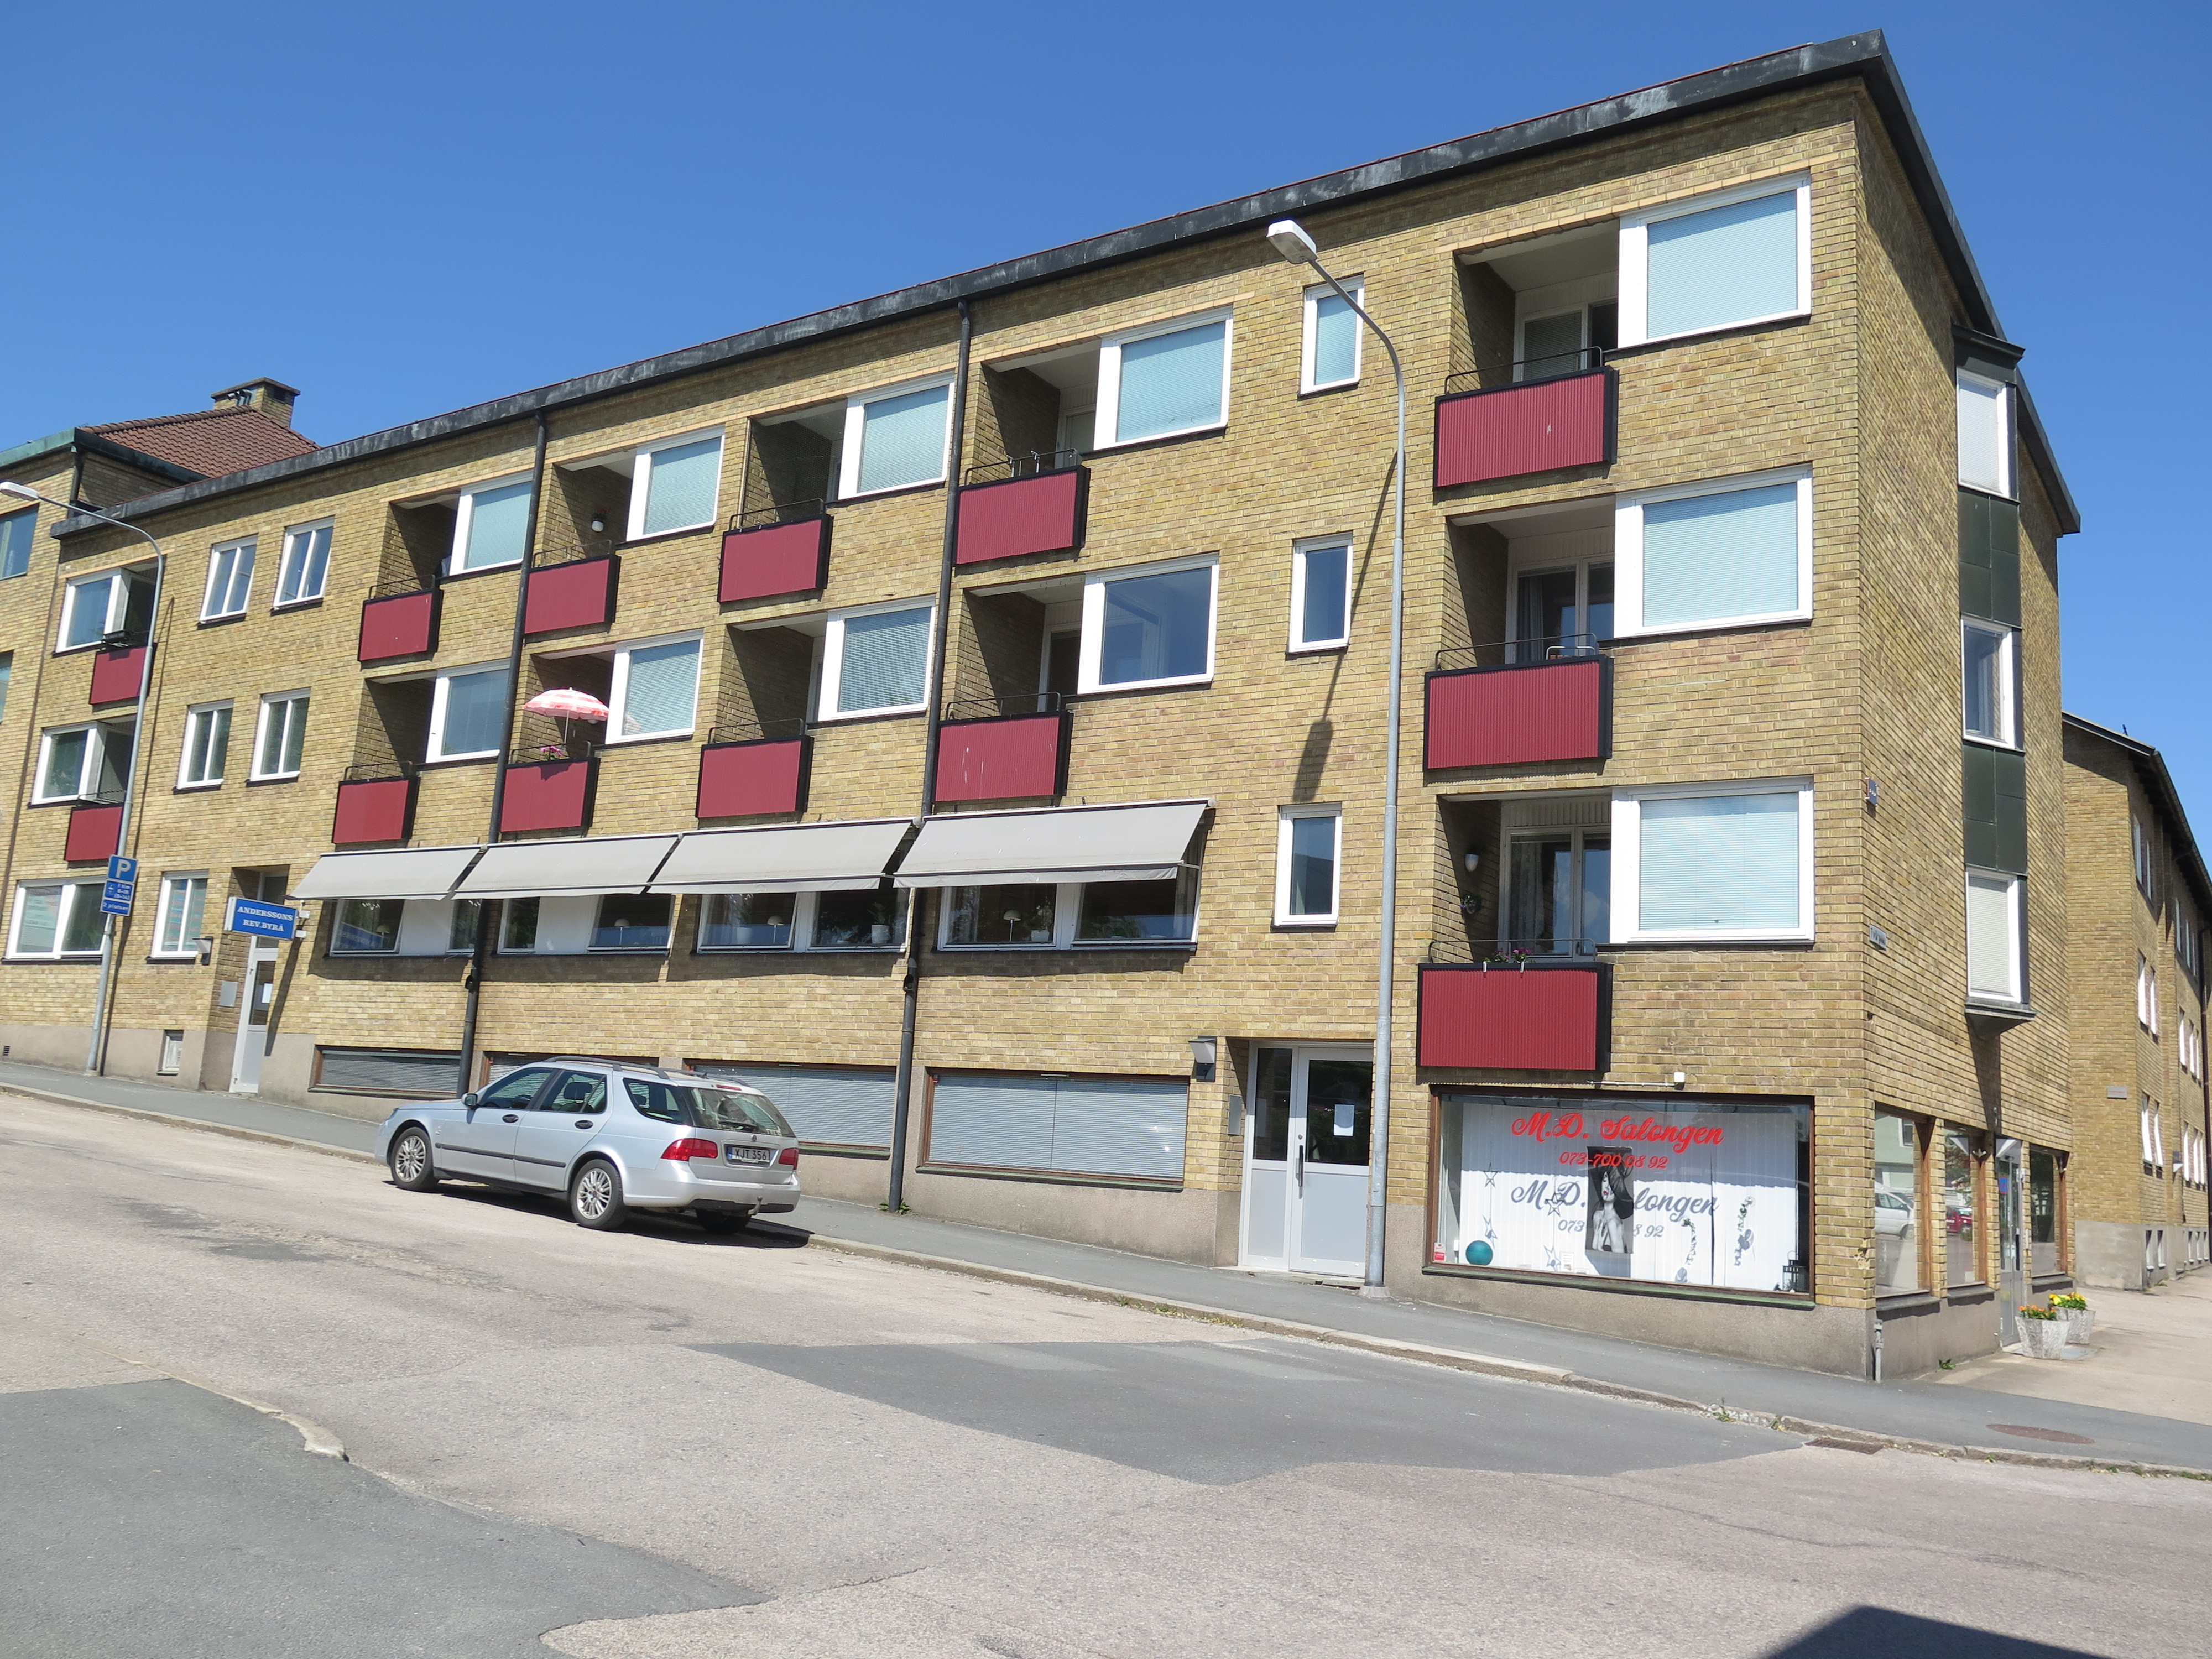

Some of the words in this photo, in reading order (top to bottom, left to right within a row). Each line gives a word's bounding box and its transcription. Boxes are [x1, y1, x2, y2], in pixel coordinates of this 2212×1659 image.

[115, 859, 131, 878] P
[237, 906, 293, 921] ANDERSSONS
[1511, 1112, 1589, 1142] M.D.
[1600, 1115, 1725, 1154] Salongen
[735, 1149, 749, 1159] XJT
[752, 1150, 767, 1160] 356
[1559, 1151, 1622, 1167] 073-700
[1625, 1155, 1647, 1168] 08
[1647, 1156, 1669, 1170] 92
[1633, 1187, 1720, 1222] longen
